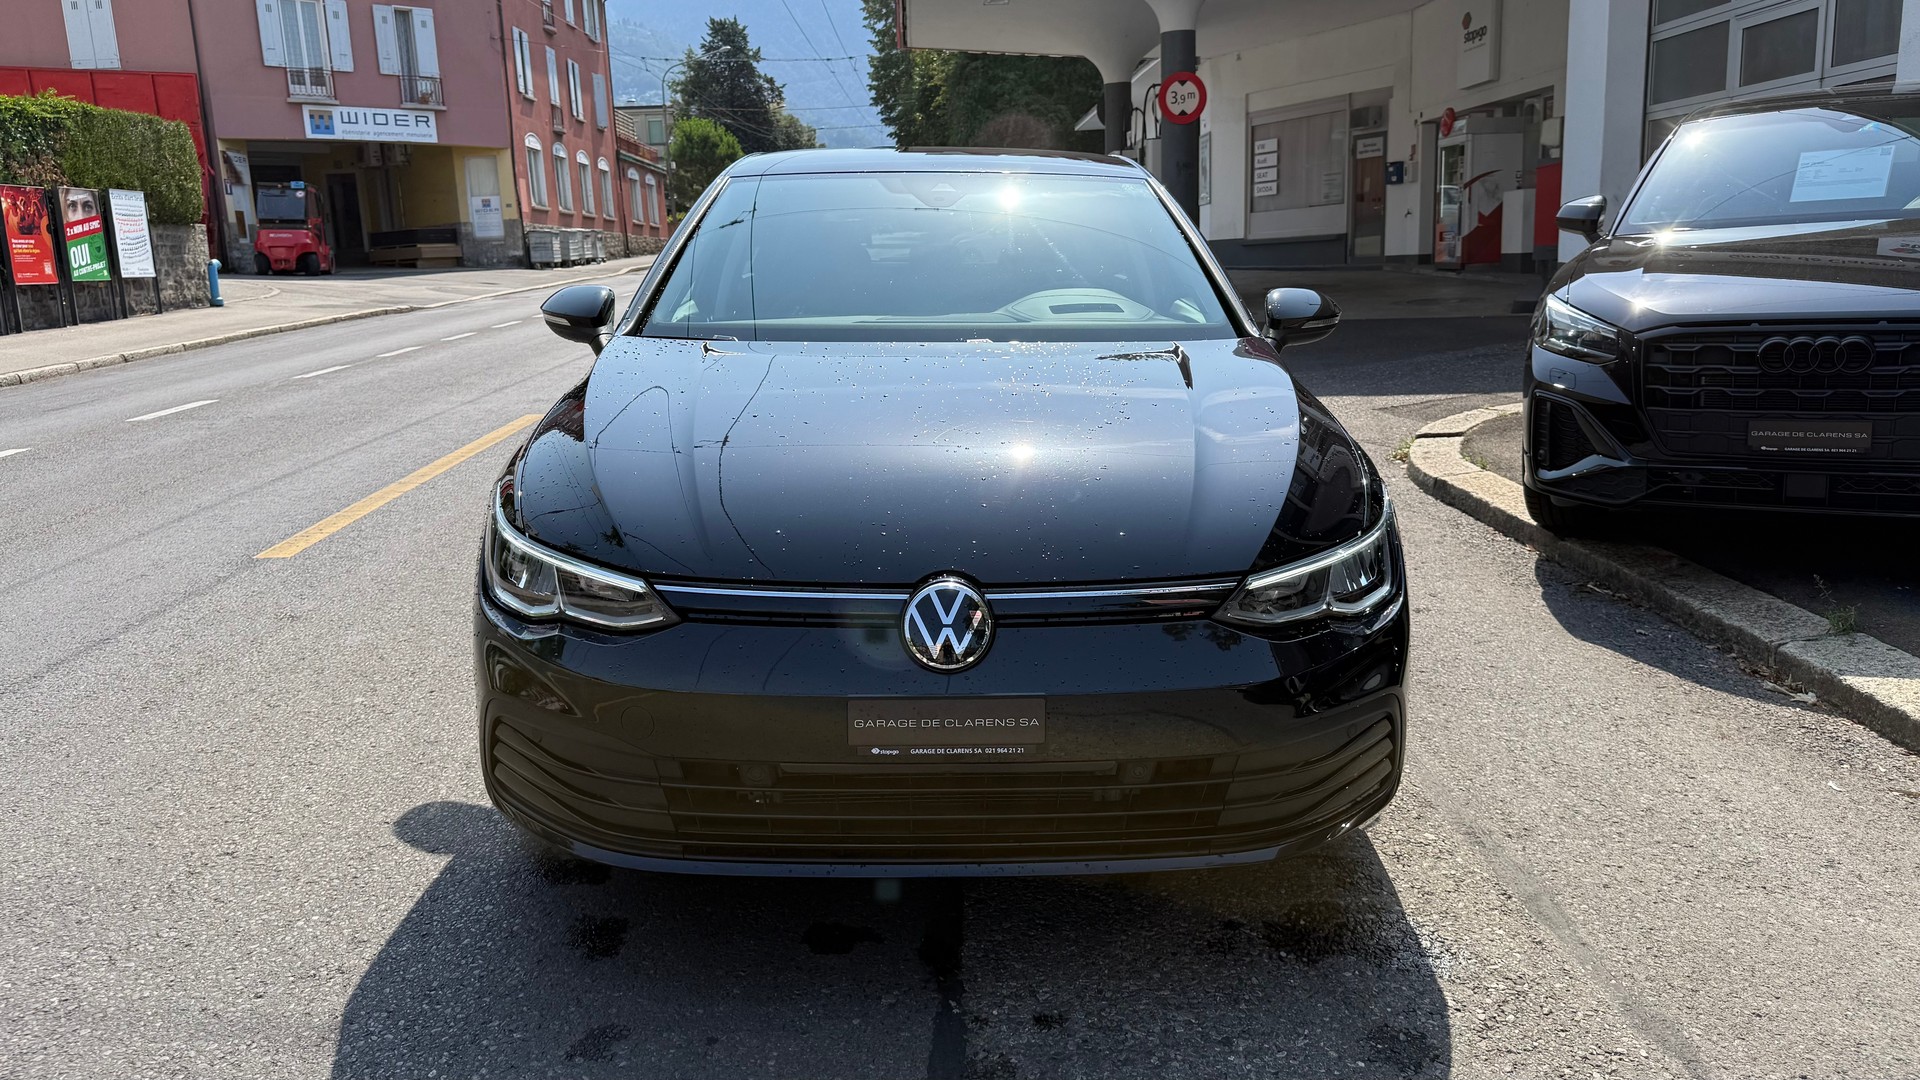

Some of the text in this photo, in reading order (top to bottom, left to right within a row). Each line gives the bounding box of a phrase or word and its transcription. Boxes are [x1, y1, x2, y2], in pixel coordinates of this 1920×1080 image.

[340, 111, 431, 128] WIDER
[73, 224, 83, 233] NON
[83, 223, 89, 231] AU
[89, 220, 101, 229] SMIC
[70, 243, 91, 268] OUI
[73, 269, 79, 277] AU
[79, 261, 106, 275] CONTRE-PROJET
[854, 718, 1040, 728] GARAGE DE CLARENS SA
